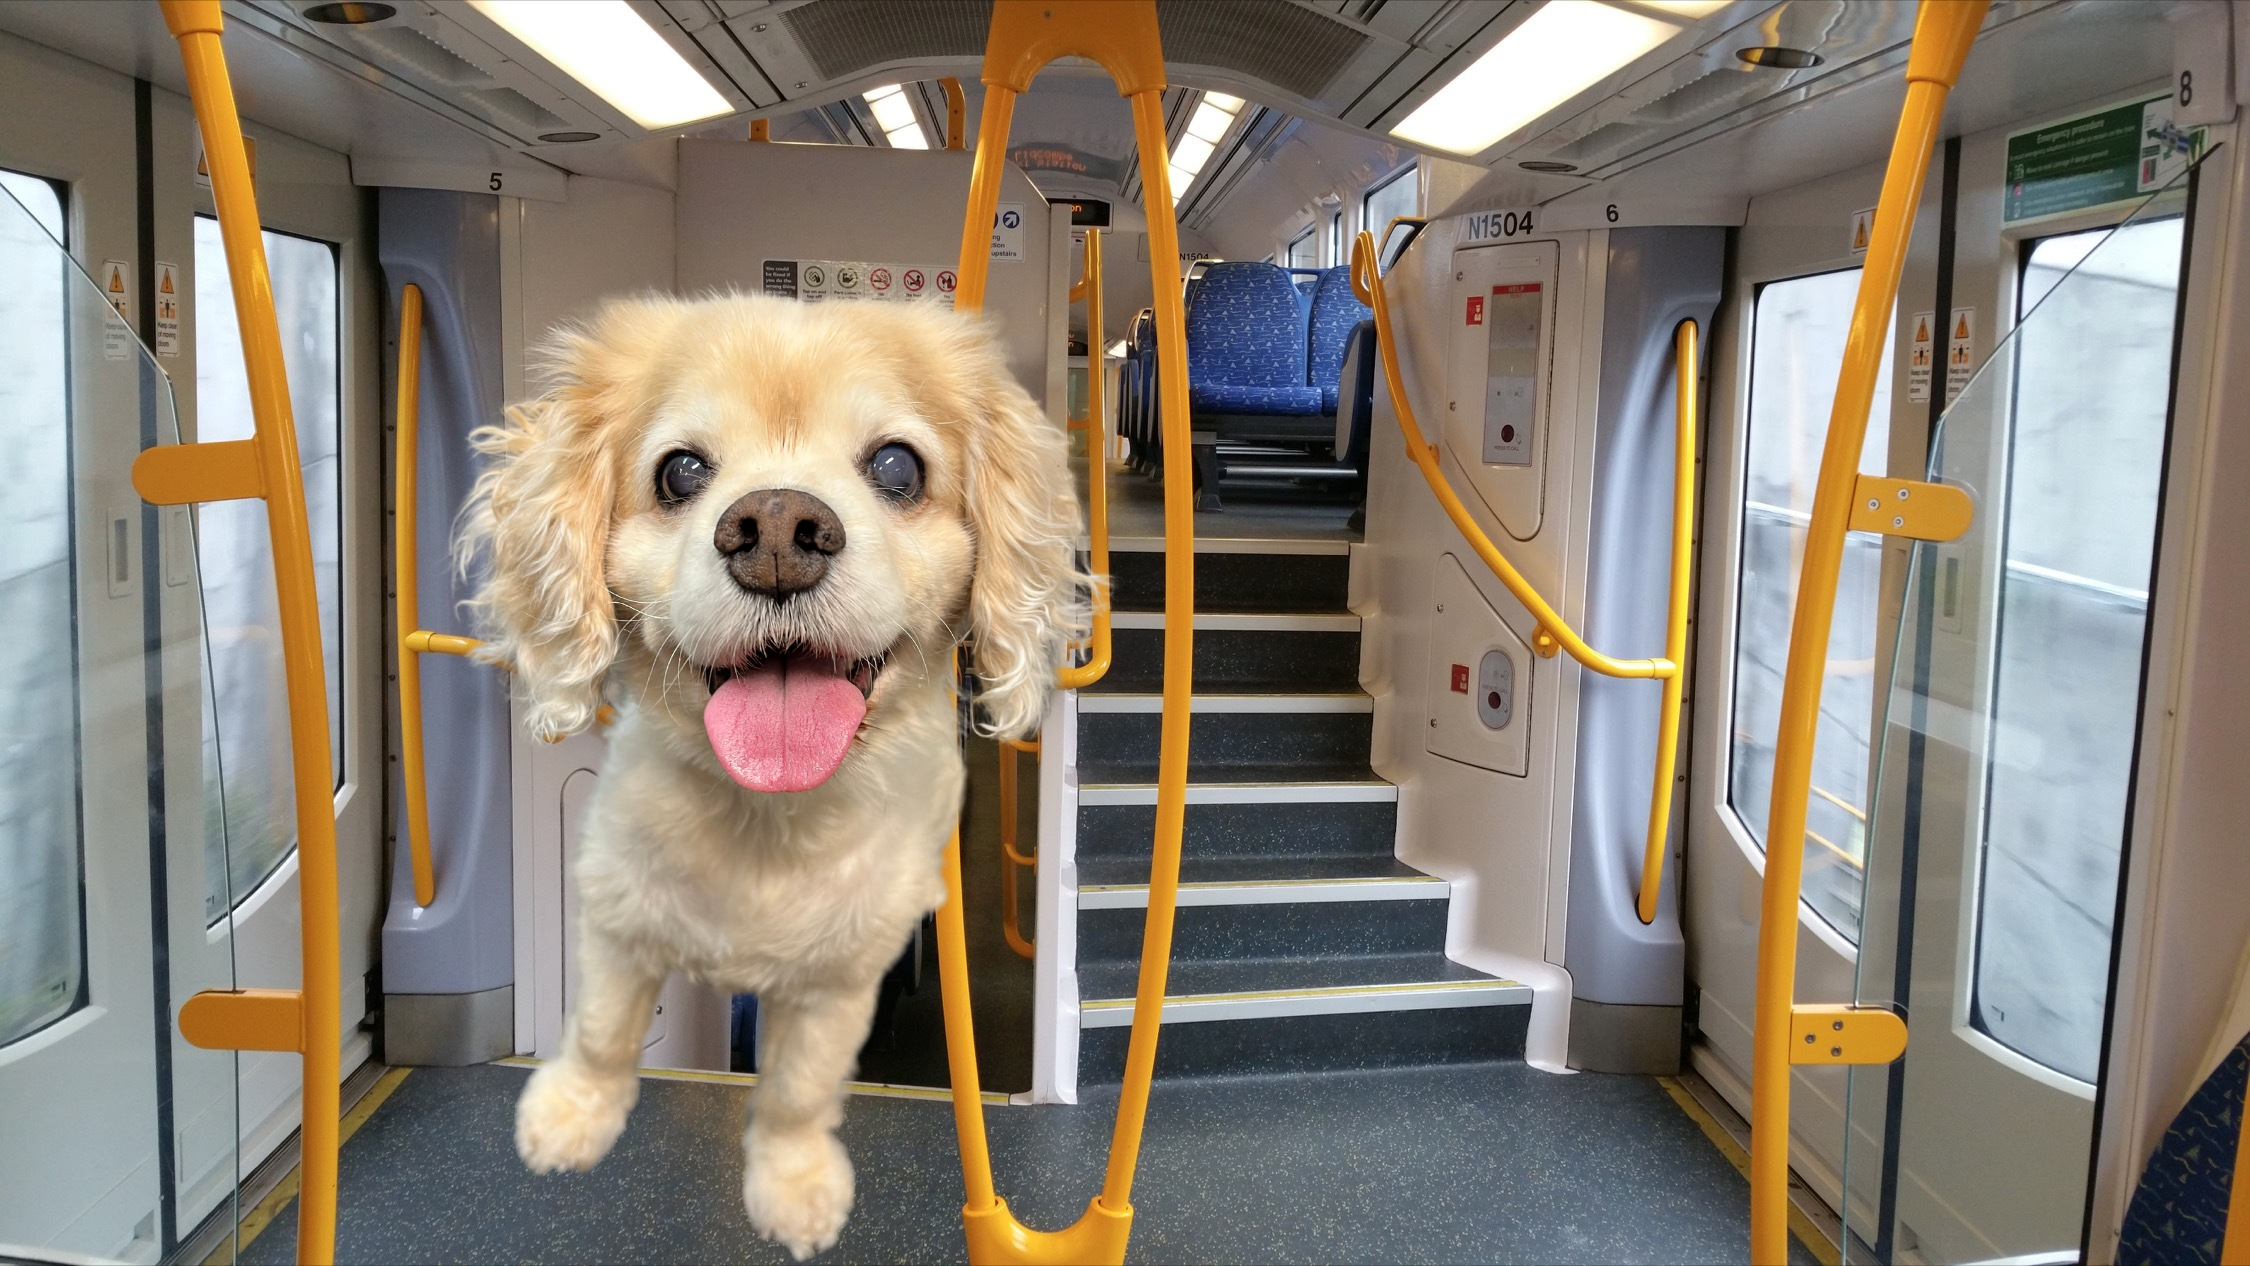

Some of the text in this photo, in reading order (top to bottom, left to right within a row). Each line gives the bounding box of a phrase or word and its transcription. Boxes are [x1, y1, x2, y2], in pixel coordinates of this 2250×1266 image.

[2180, 70, 2192, 107] 8
[2036, 119, 2105, 145] Emergency procedure
[489, 172, 502, 191] 5
[1606, 204, 1618, 222] 6
[1468, 211, 1533, 240] N1504
[991, 250, 1017, 258] upstairs
[163, 332, 176, 340] moving
